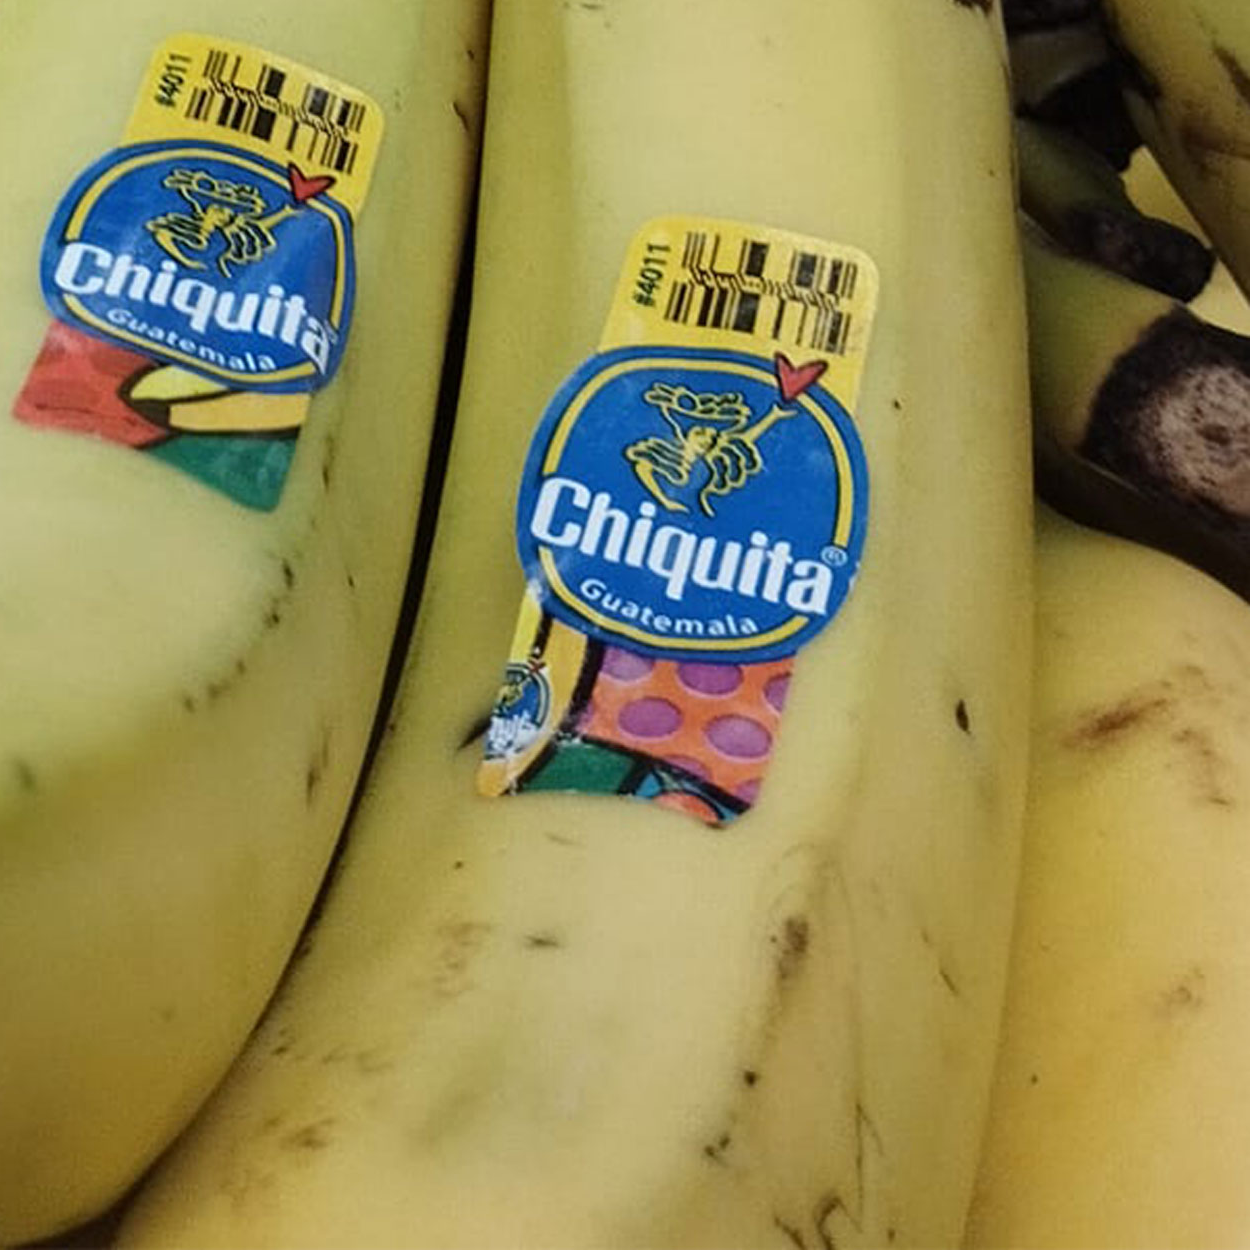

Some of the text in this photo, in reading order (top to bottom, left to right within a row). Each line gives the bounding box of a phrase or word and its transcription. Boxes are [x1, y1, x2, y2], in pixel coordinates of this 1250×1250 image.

[154, 53, 193, 107] #4011
[632, 243, 671, 307] #4011
[54, 241, 332, 375] Chiquita
[106, 307, 277, 372] Guatemala
[529, 477, 833, 616] Chiquita
[579, 578, 758, 637] Guatemala
